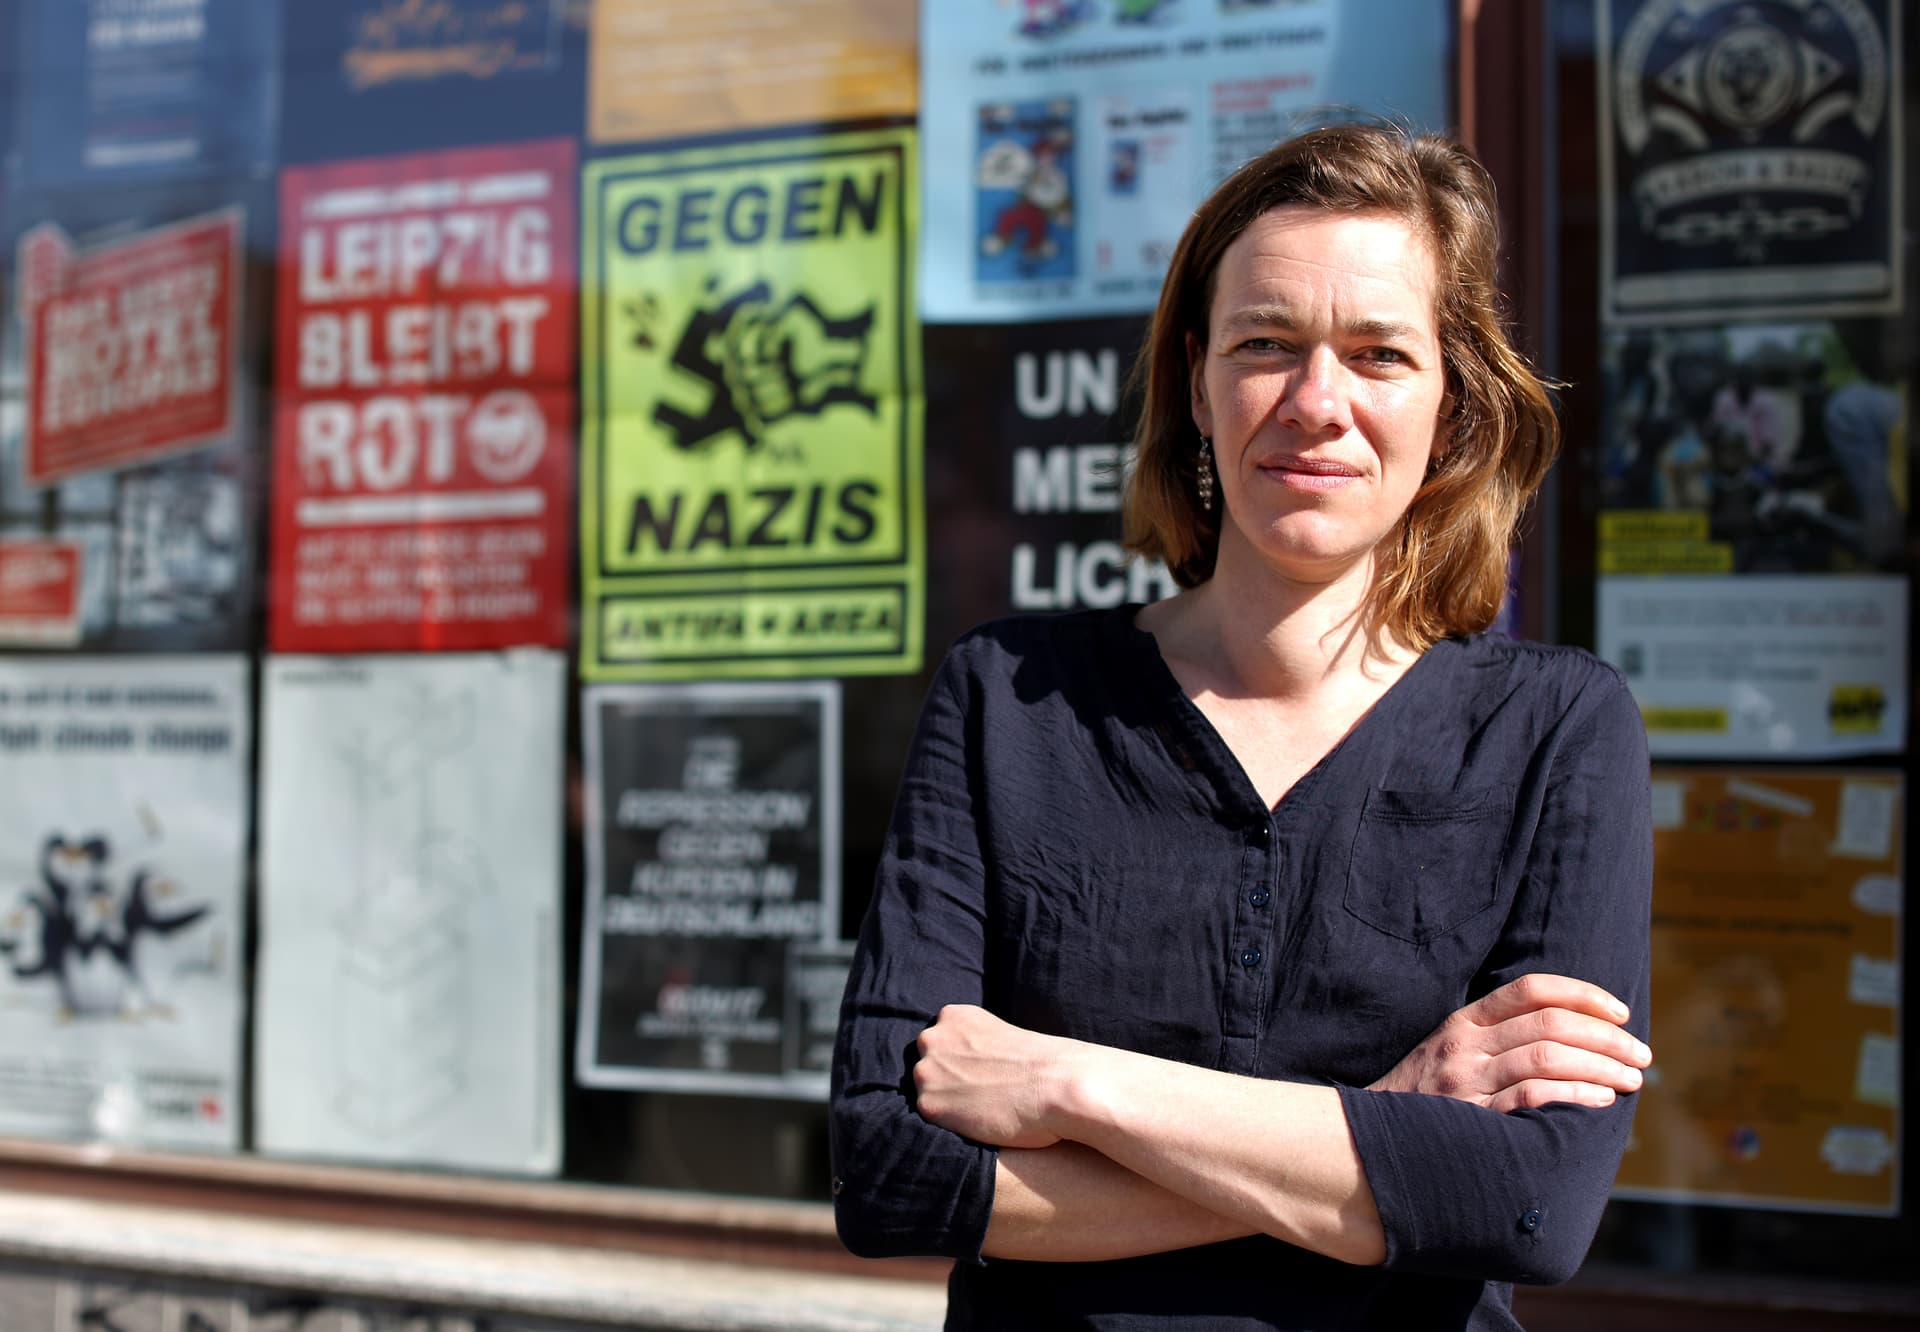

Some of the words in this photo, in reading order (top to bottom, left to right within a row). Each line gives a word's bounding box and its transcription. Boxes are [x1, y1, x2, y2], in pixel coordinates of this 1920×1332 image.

[301, 209, 551, 302] LEIPZIG
[616, 170, 885, 257] GEGEN
[301, 299, 550, 388] BLEIBT
[1015, 350, 1118, 417] UN
[300, 395, 464, 490] ROT
[625, 482, 880, 556] NAZIS
[786, 604, 896, 636] AREA
